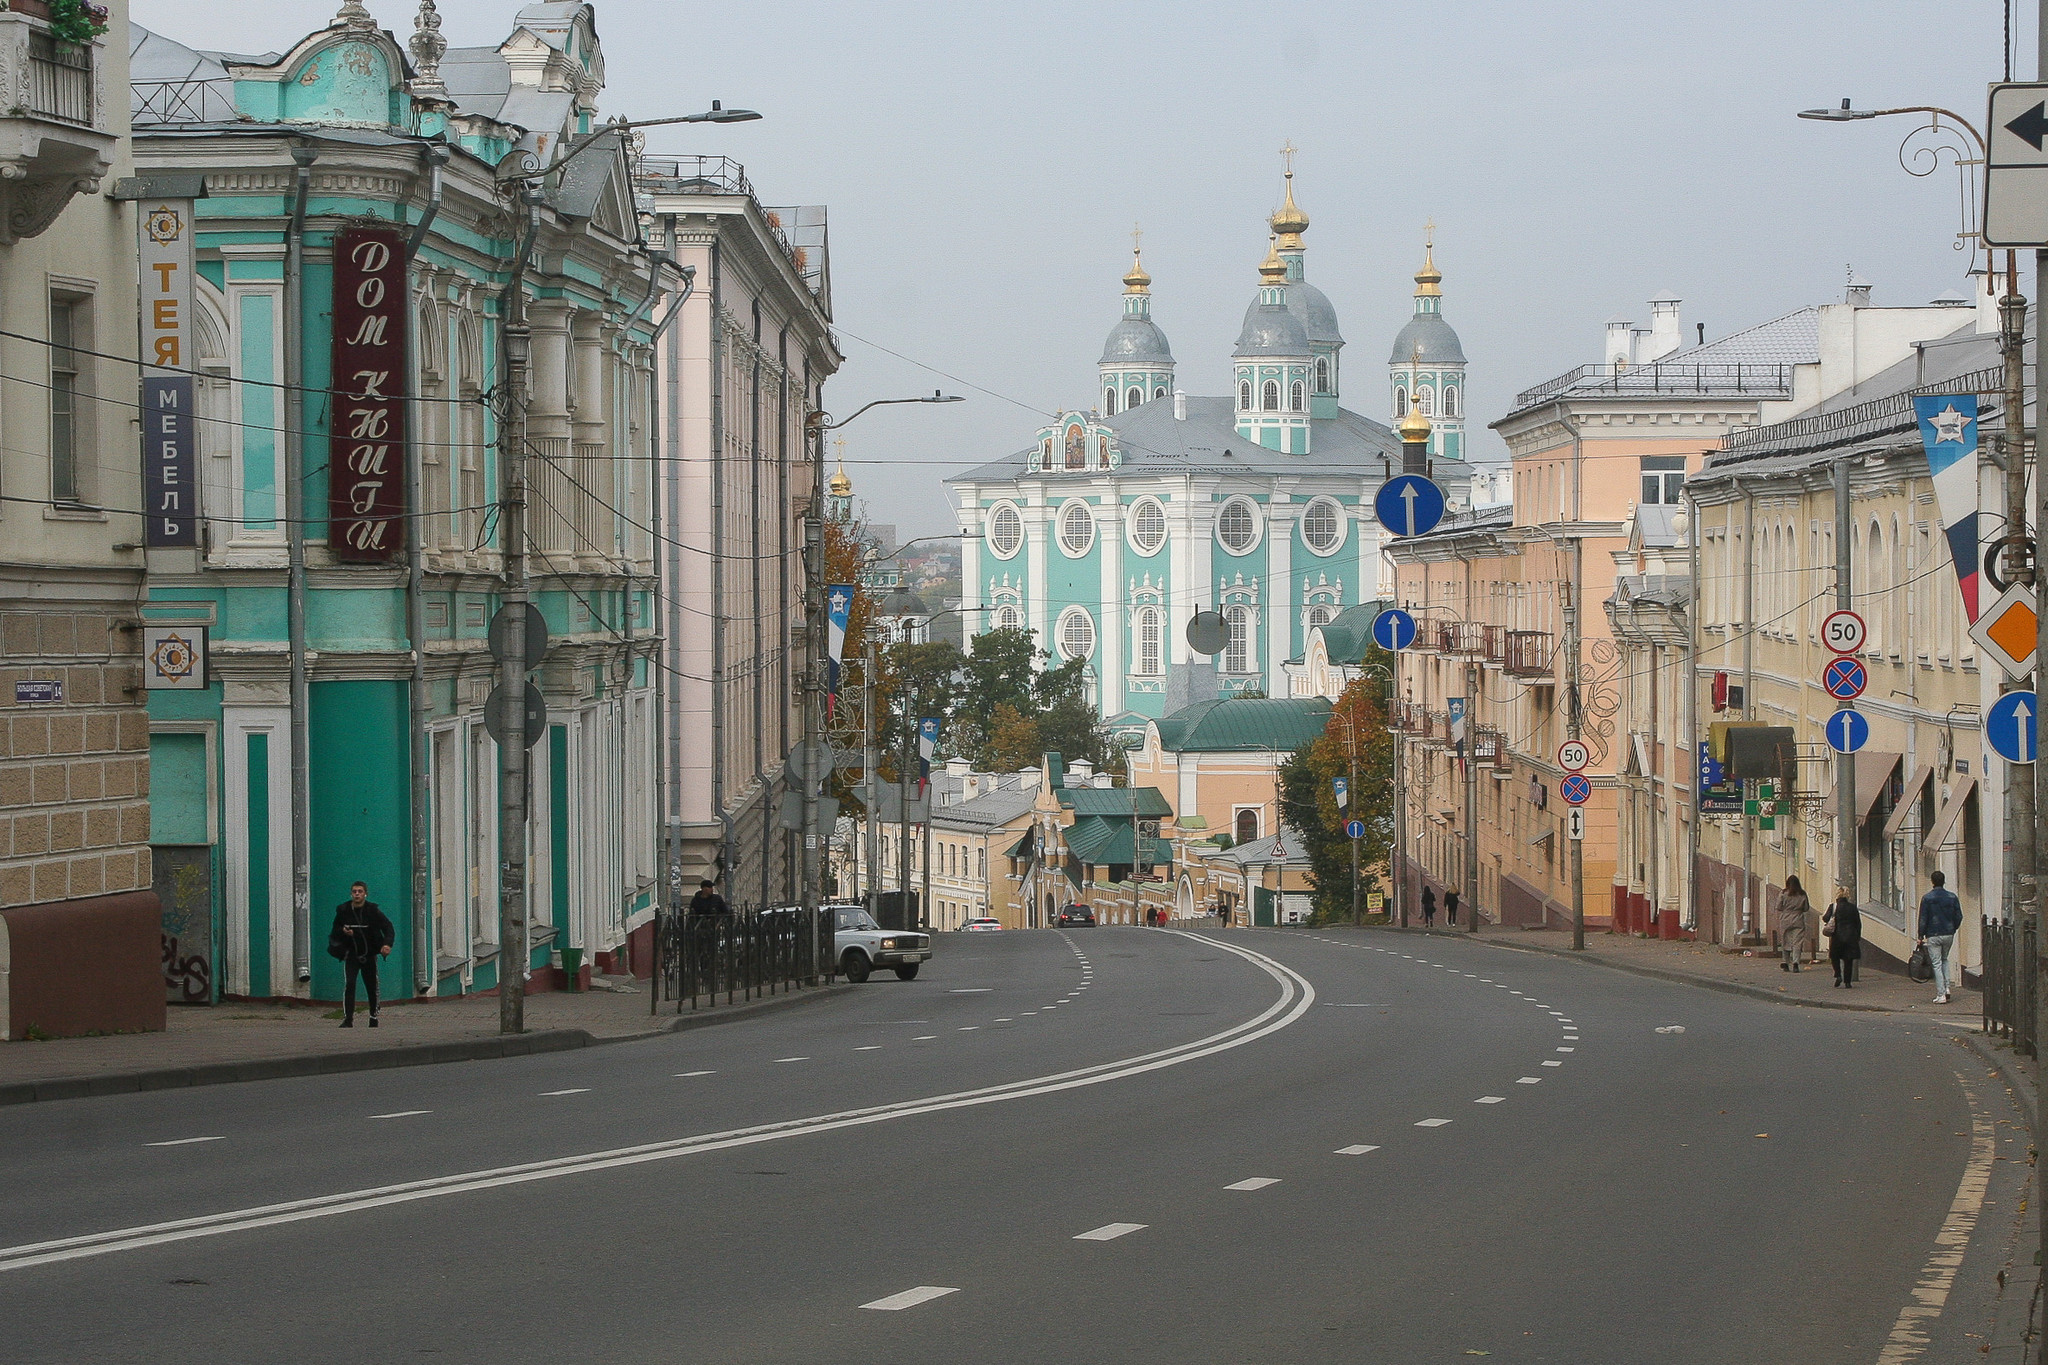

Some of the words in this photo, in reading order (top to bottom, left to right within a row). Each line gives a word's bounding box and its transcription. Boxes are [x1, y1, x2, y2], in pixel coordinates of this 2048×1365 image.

[152, 263, 179, 366] ТЕЯ
[346, 241, 390, 346] ДОМ
[159, 389, 179, 536] МЕБЕЛЬ
[346, 370, 389, 551] КНИГИ
[1831, 622, 1856, 641] 50
[55, 686, 62, 697] 14
[1565, 749, 1582, 762] 50
[1702, 745, 1710, 784] КАФЕ
